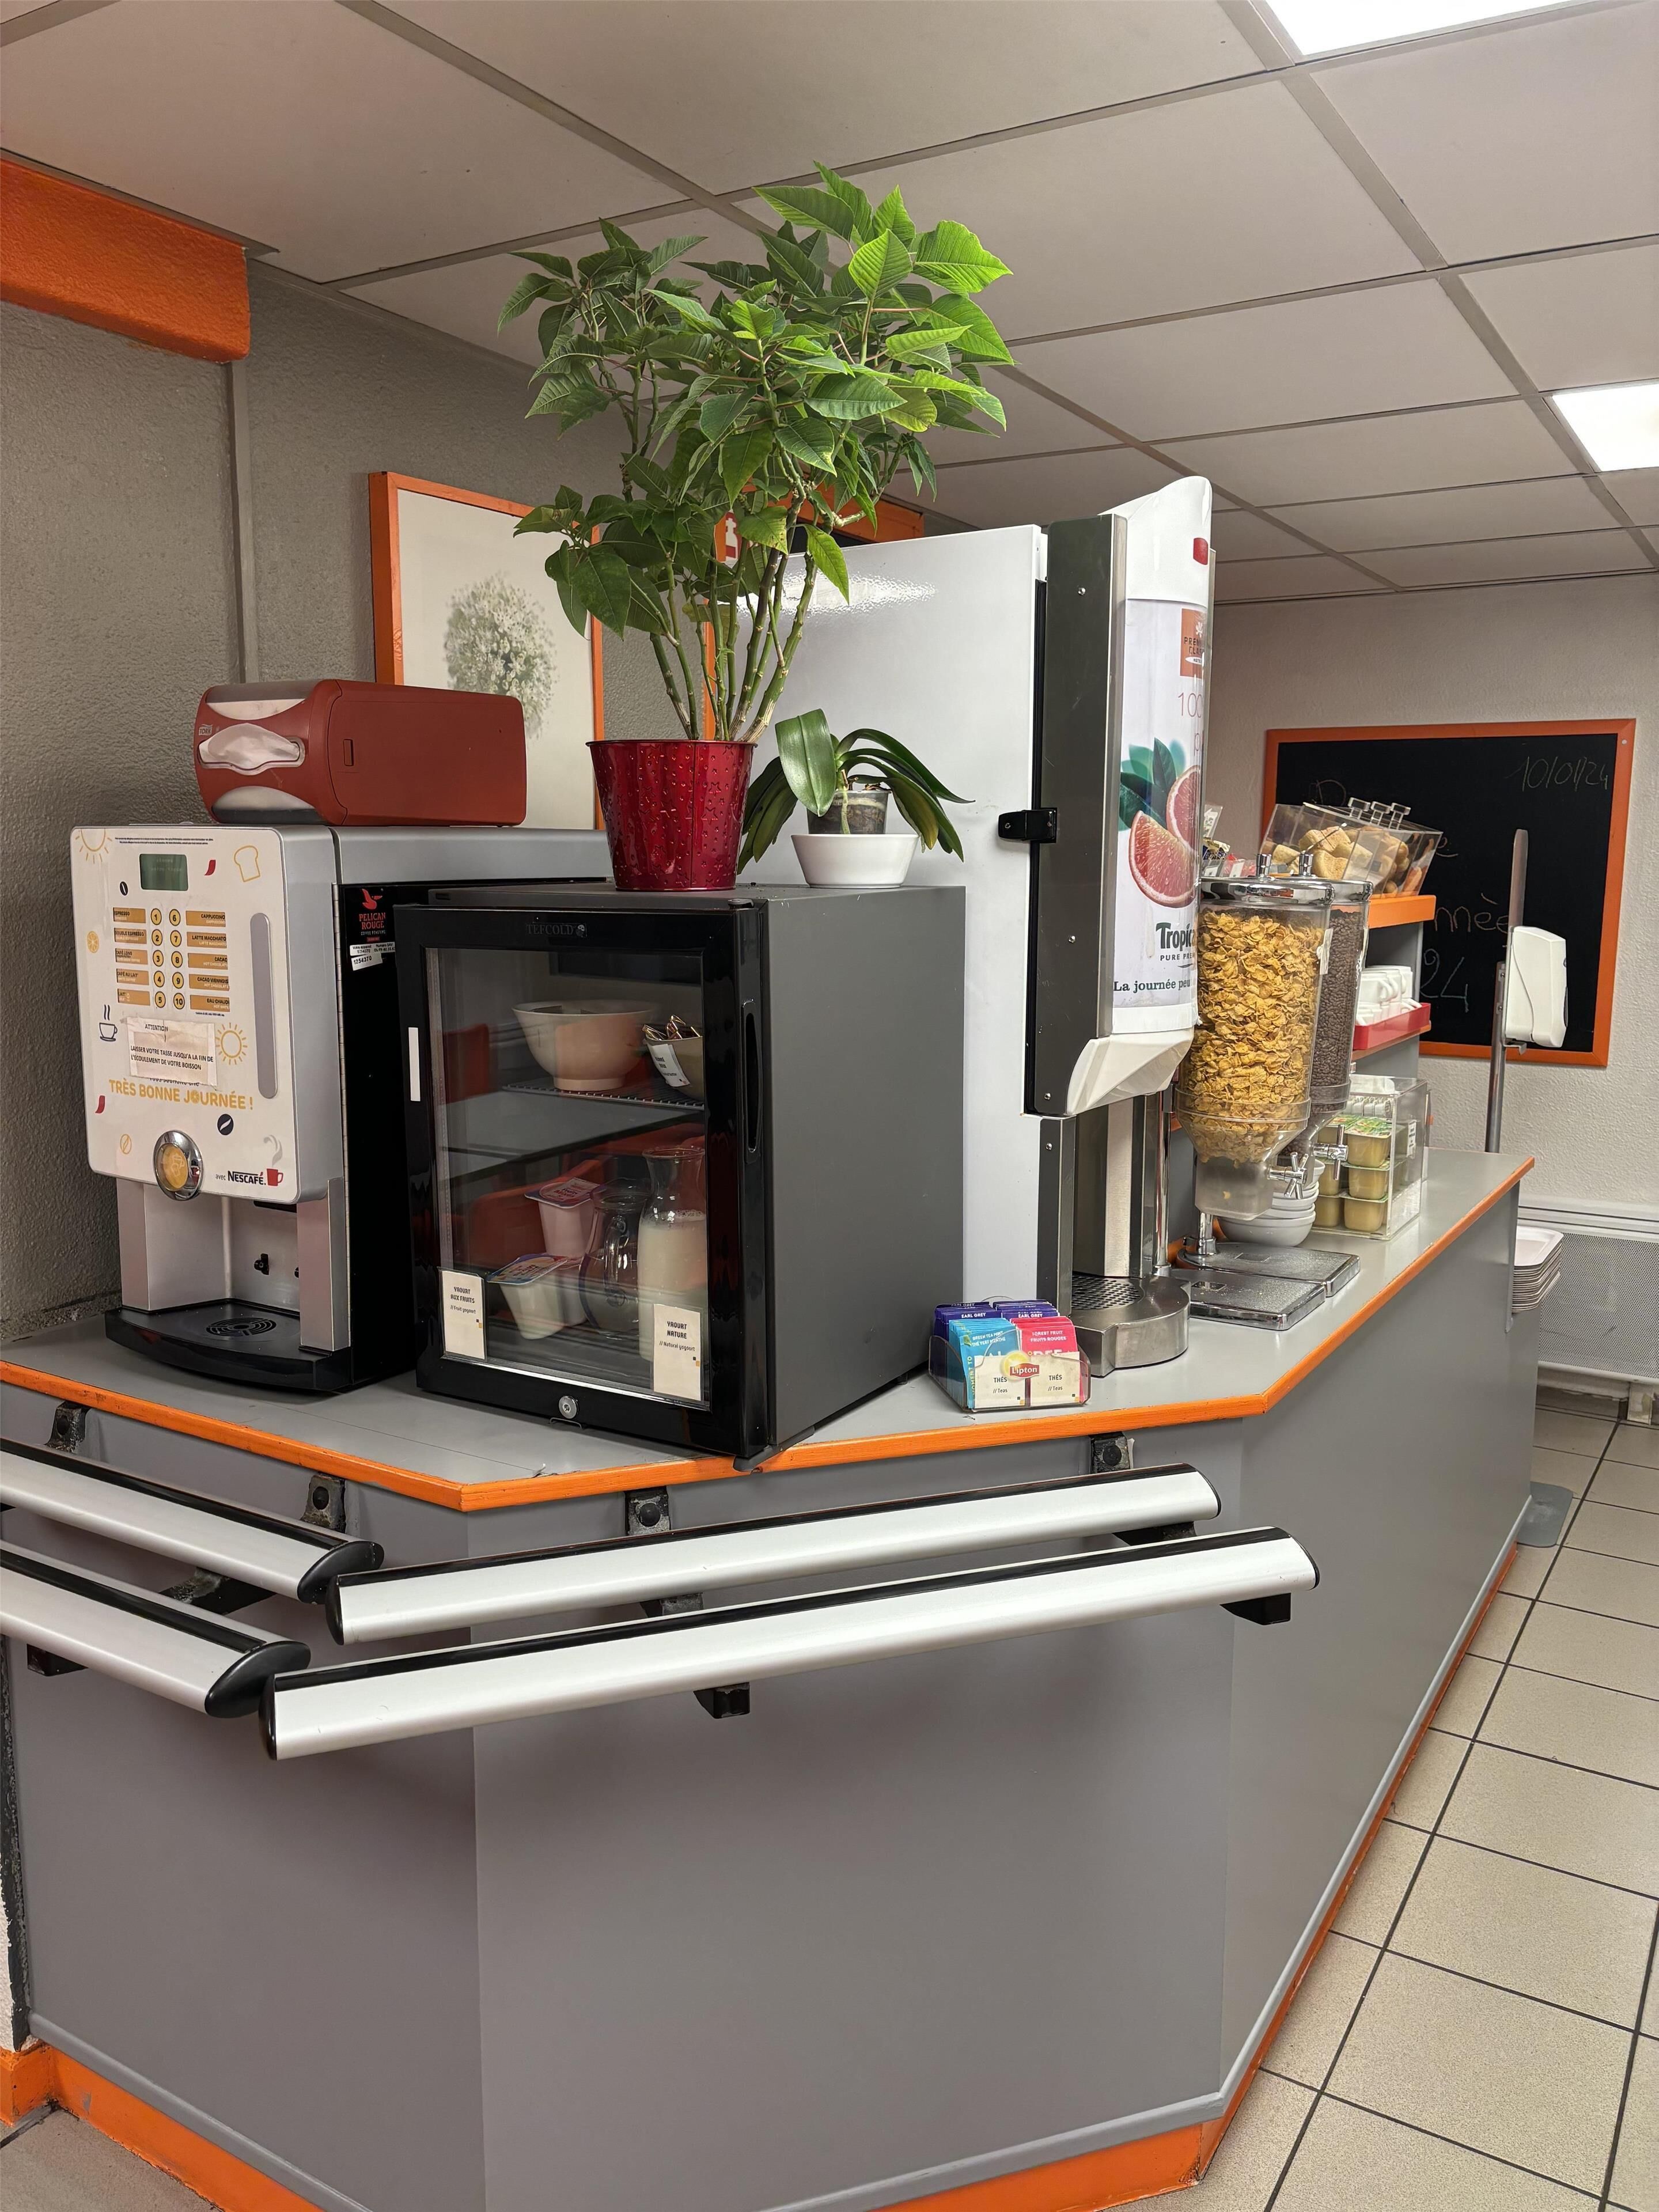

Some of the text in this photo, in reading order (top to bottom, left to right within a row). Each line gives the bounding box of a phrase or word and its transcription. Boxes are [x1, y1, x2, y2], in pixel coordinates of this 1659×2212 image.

[359, 912, 386, 922] PELICAN
[361, 921, 385, 930] ROUGE
[525, 924, 574, 935] TEFCOLD
[1113, 981, 1130, 991] La
[1133, 979, 1176, 994] journée
[145, 1024, 168, 1032] ATTENTION
[173, 1051, 191, 1059] JUSQU'A
[131, 1054, 160, 1064] L'ECOULEMENT
[167, 1059, 181, 1067] VOTRE
[182, 1062, 202, 1070] BOISSON
[109, 1078, 136, 1096] TRÈS
[139, 1085, 180, 1102] BONNE
[184, 1089, 246, 1109] JOURNÉE
[667, 1321, 687, 1330] YAOURT
[667, 1330, 687, 1339] NATURE
[1012, 1366, 1037, 1376] Lipton
